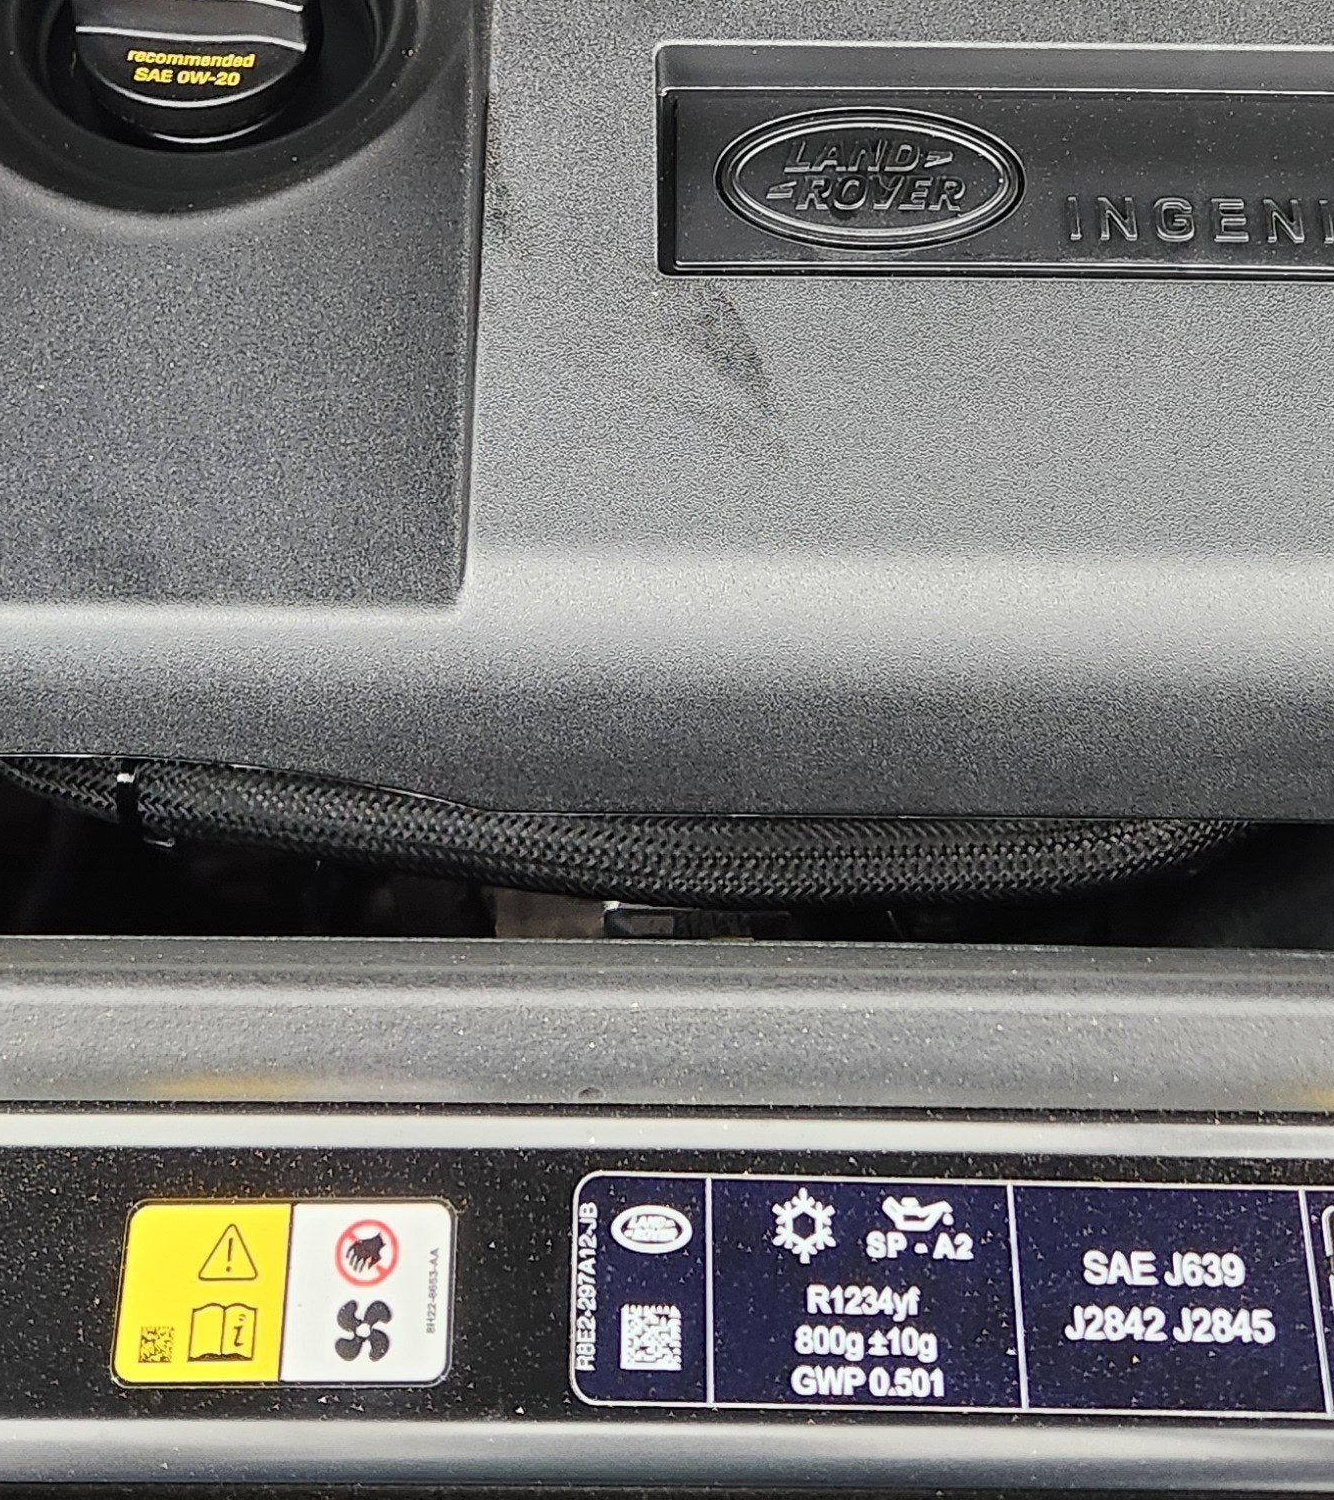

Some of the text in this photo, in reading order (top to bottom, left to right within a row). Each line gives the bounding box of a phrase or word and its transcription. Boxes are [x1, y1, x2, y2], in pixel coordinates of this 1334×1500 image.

[127, 50, 255, 68] recommended
[133, 67, 241, 86] SAE 0W-20
[784, 139, 921, 172] LAND
[795, 175, 966, 211] ROVER
[866, 1230, 907, 1259] SP
[932, 1232, 975, 1260] A2
[1083, 1250, 1246, 1288] SAE J639
[806, 1284, 921, 1322] R1234yf
[1064, 1305, 1276, 1344] J2842 J2845
[794, 1324, 938, 1363] 800g ±10g
[790, 1365, 945, 1398] GWP 0.501
